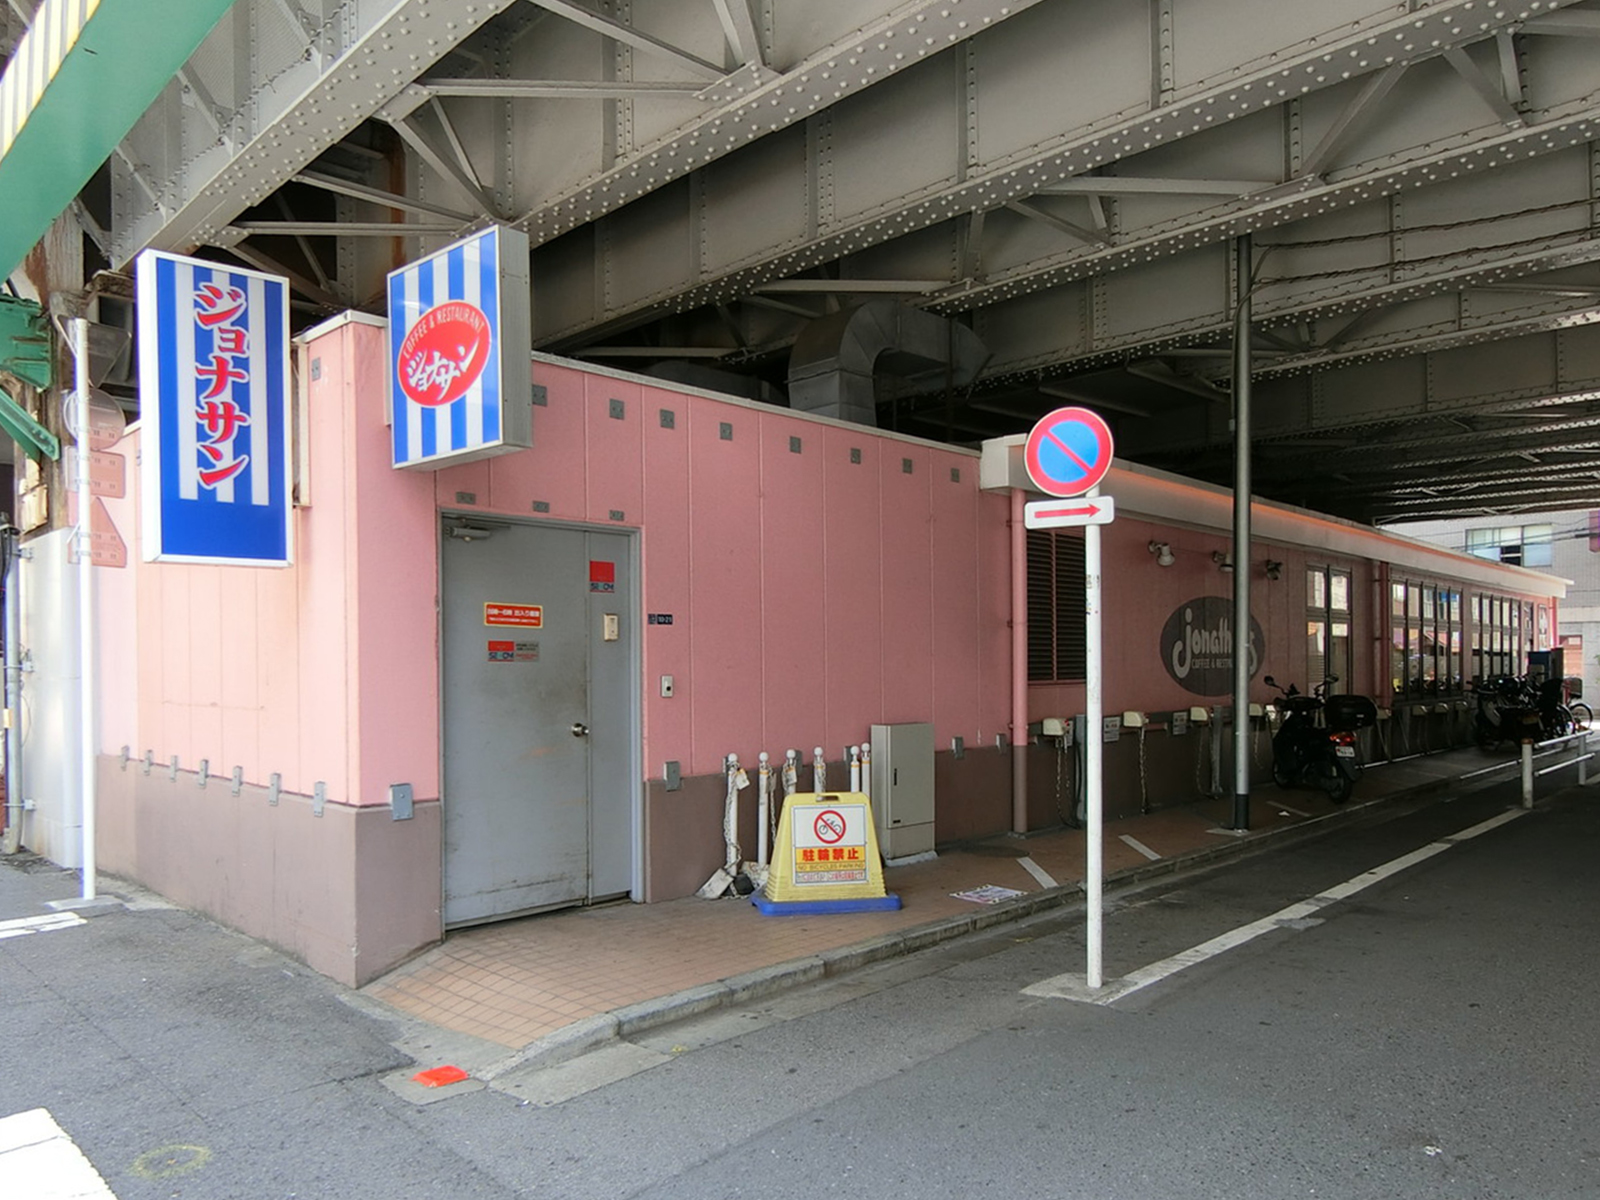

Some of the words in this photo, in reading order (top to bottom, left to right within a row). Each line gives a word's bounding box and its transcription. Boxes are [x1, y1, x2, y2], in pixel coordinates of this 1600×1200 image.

[403, 320, 428, 359] COFFEE
[429, 315, 435, 329] &
[436, 306, 485, 333] RESTAURANT
[194, 283, 249, 489] ジョナサン
[406, 336, 479, 401] ジョナサン
[1172, 607, 1257, 678] jonaths
[802, 847, 859, 862] 駐輪禁止
